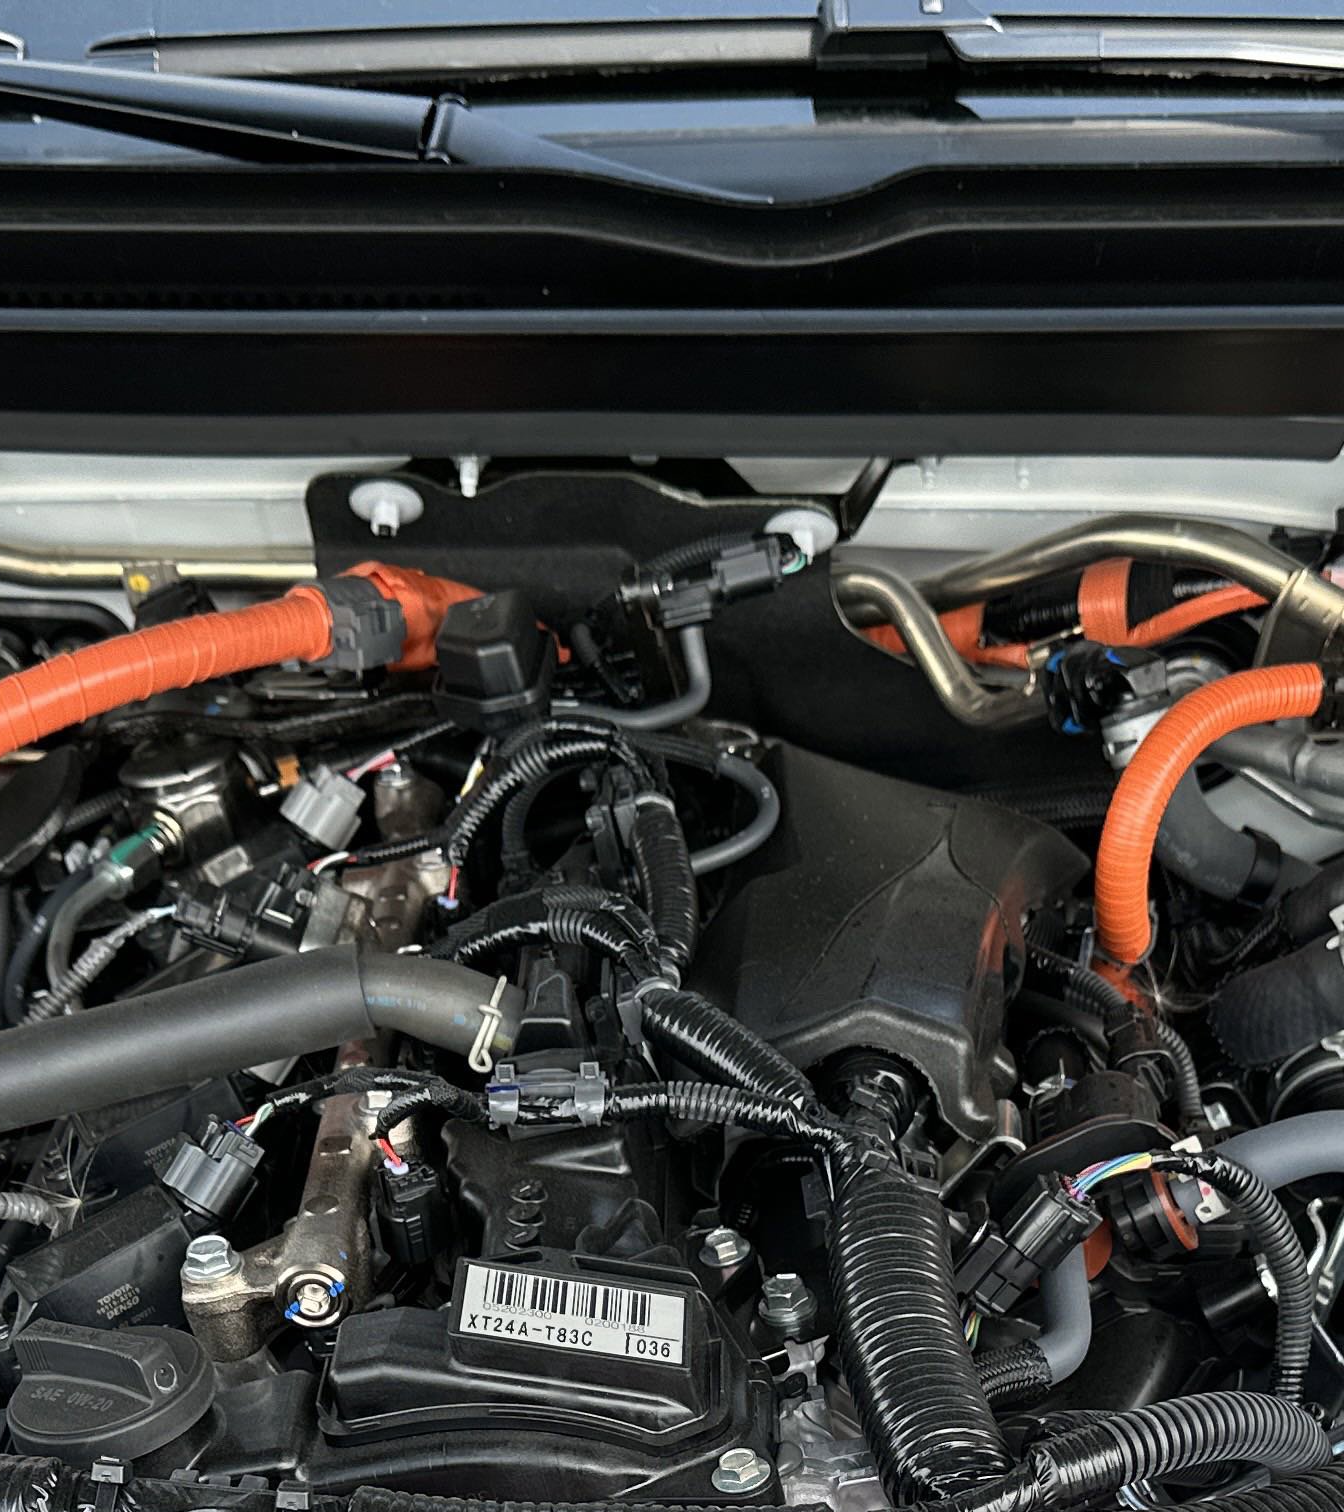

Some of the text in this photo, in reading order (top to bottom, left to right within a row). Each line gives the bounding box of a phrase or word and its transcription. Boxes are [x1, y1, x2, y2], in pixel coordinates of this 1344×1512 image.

[97, 1283, 133, 1306] TOYOTA
[106, 1295, 140, 1320] DENSO
[467, 1313, 671, 1358] XT24A-T83C 036
[31, 1386, 113, 1412] SAE 0W-20
